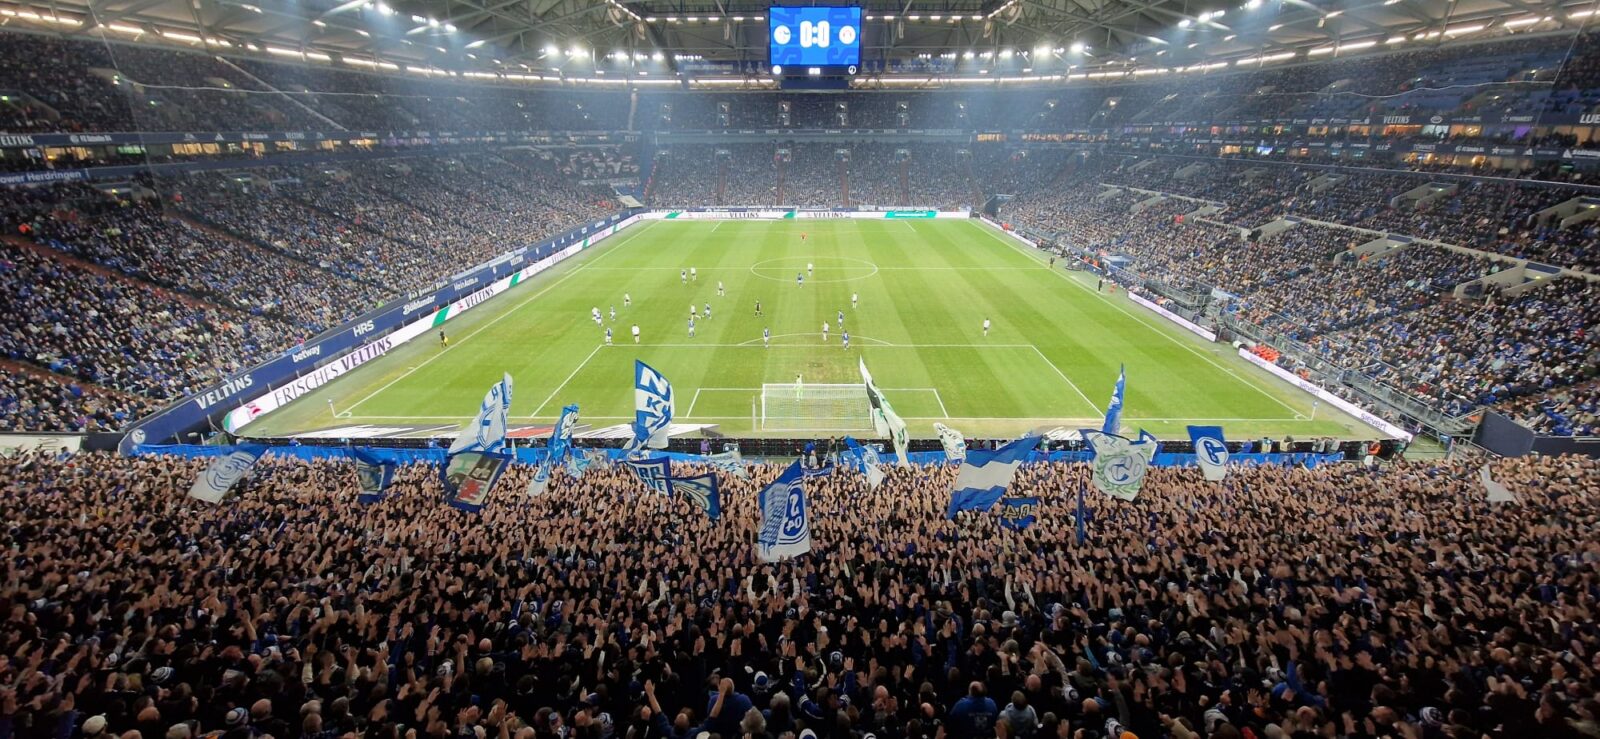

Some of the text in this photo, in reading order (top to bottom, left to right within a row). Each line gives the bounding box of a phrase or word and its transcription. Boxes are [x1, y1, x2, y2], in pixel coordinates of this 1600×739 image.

[800, 21, 830, 48] 0:0
[26, 170, 82, 182] Herdringen
[464, 287, 495, 308] VELTINS
[353, 319, 375, 337] HRS
[292, 345, 320, 363] betway
[274, 336, 392, 407] FRISCHES VELTINS
[194, 374, 253, 410] VELTINS
[1361, 413, 1387, 432] sievert
